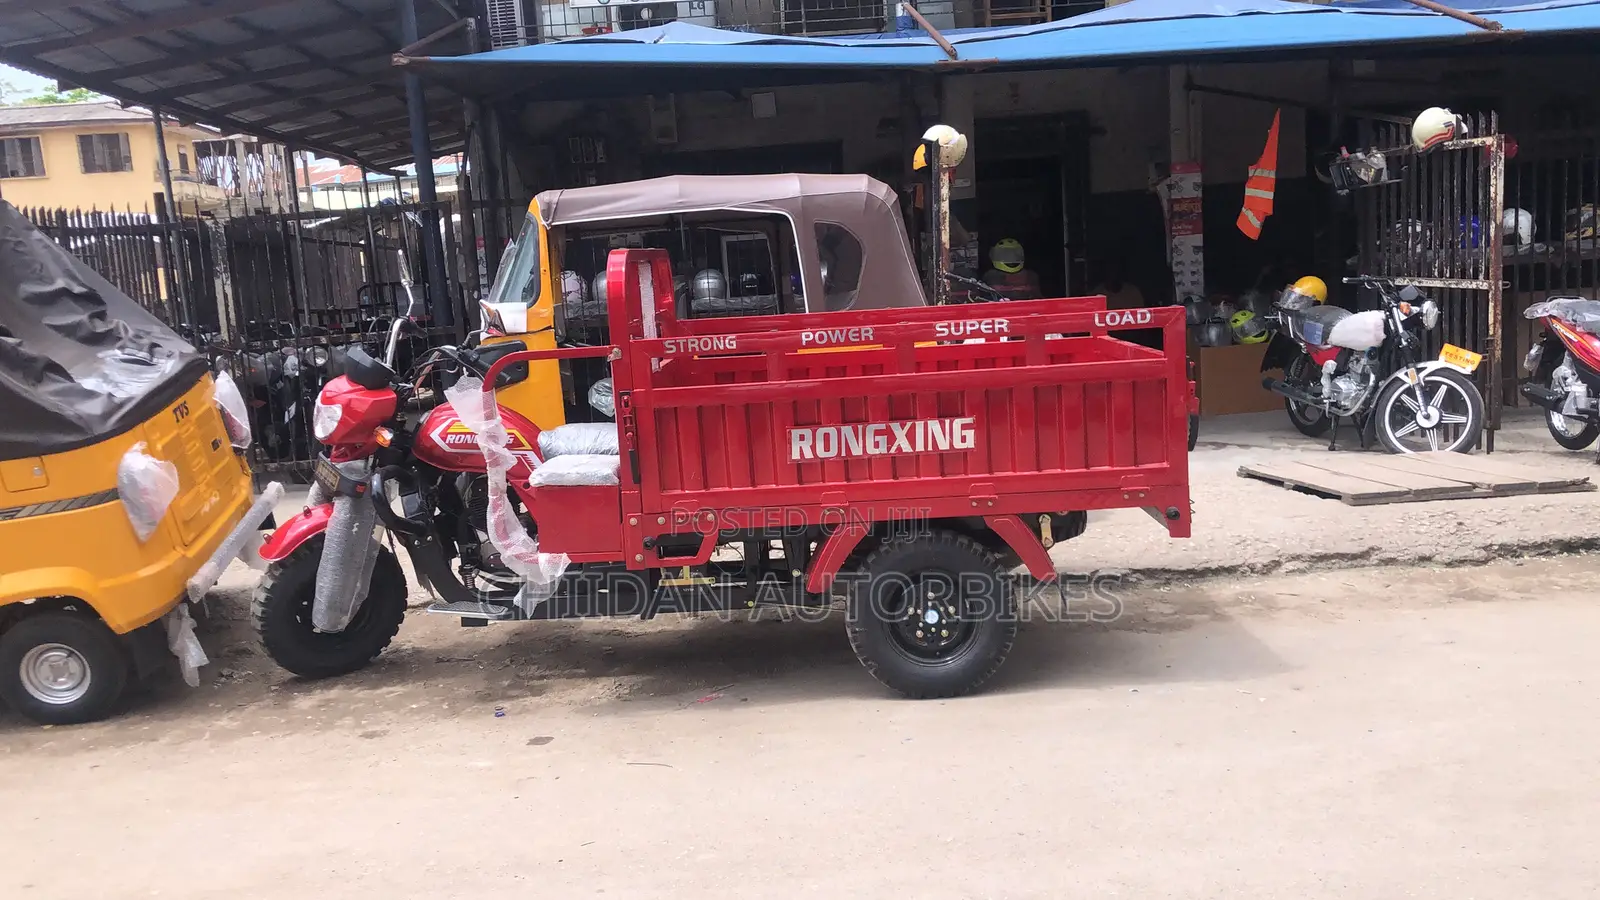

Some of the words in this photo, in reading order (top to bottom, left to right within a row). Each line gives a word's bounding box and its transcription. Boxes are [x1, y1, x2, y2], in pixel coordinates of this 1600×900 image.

[663, 335, 737, 354] STRONG
[801, 327, 875, 346] POWER
[935, 319, 1010, 337] SUPER
[1094, 309, 1152, 327] LOAD
[172, 400, 190, 423] TVS
[445, 434, 515, 444] RONG
[790, 417, 976, 460] RONGXING
